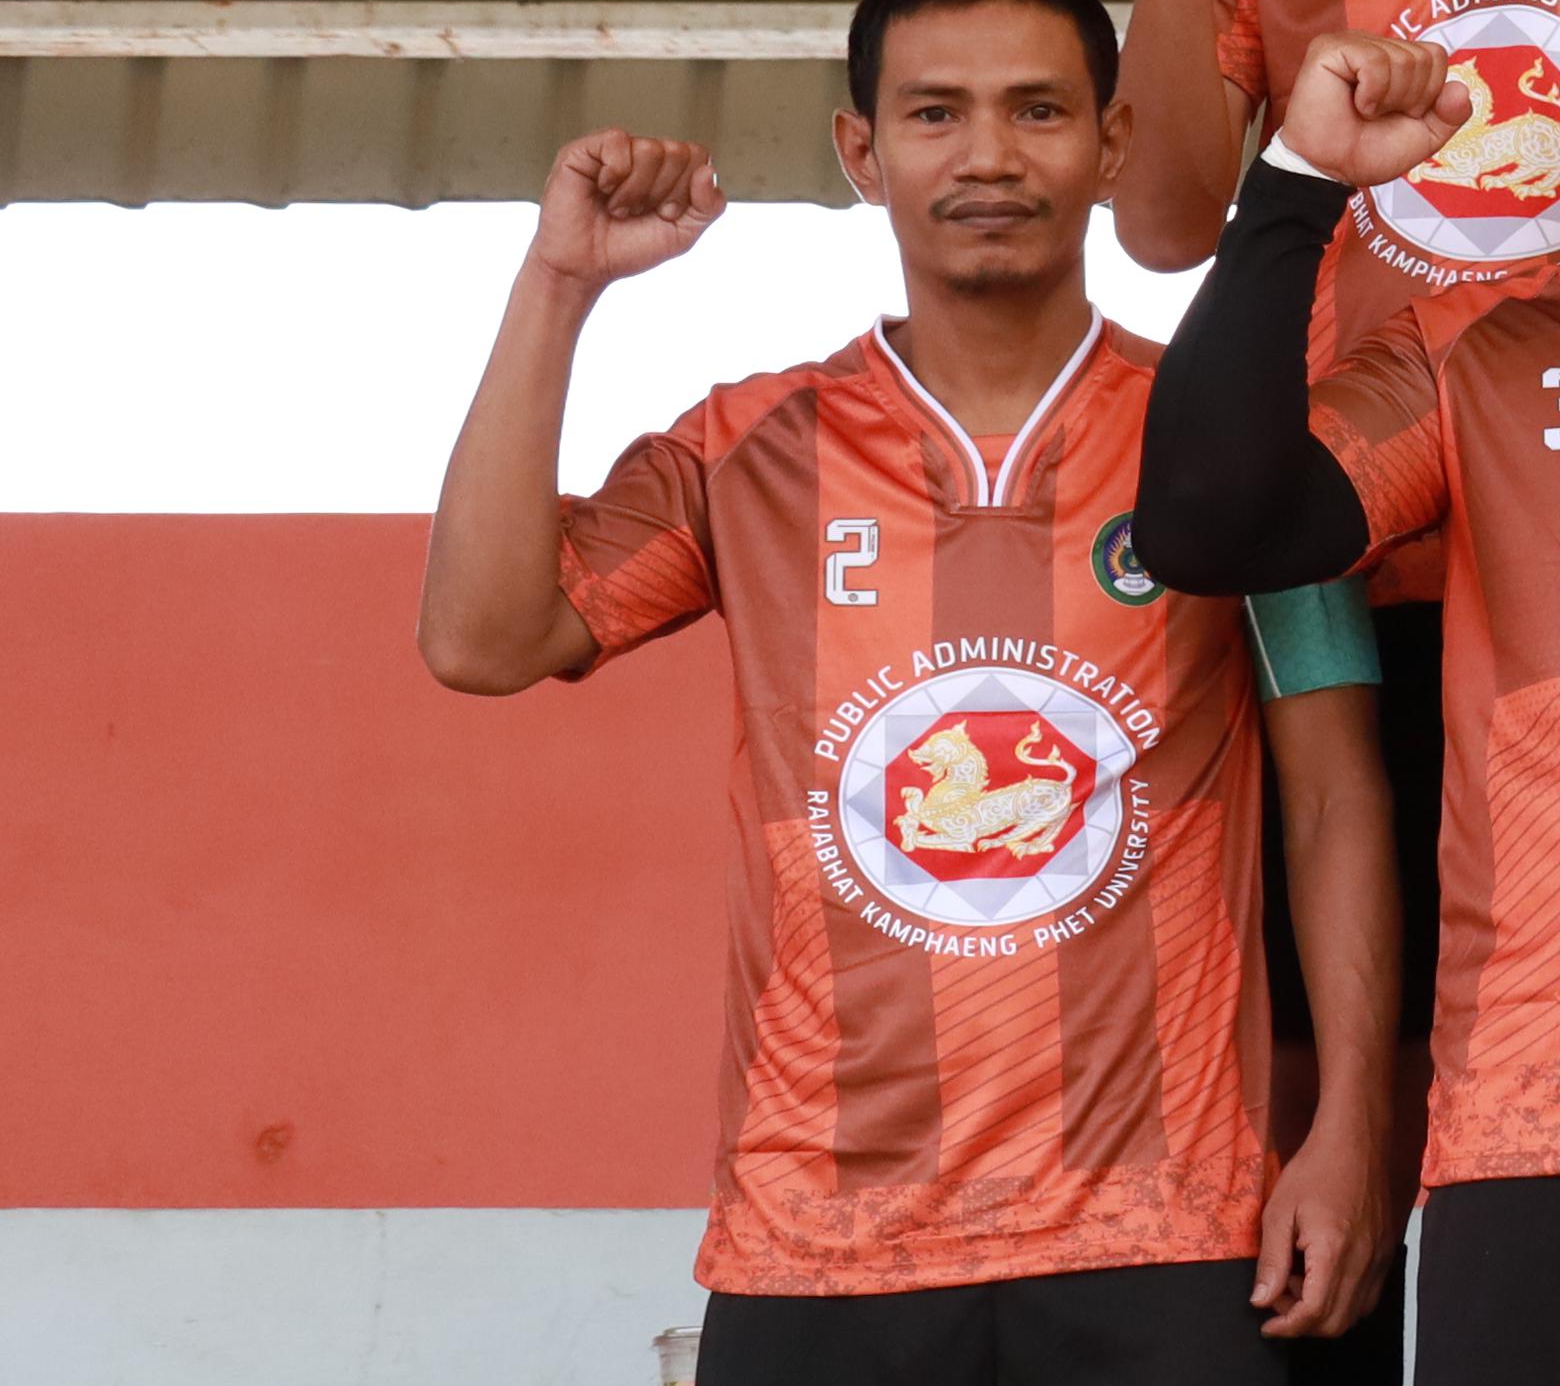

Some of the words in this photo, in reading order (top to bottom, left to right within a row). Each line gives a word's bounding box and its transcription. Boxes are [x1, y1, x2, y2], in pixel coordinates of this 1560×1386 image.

[824, 518, 880, 606] 2
[814, 665, 904, 762] PUBLIC
[912, 637, 1163, 751] ADMINISTRATION
[860, 899, 1018, 958] KAMPHAENG
[1035, 907, 1097, 949] PHET
[1094, 778, 1150, 909] UNIVERSITY
